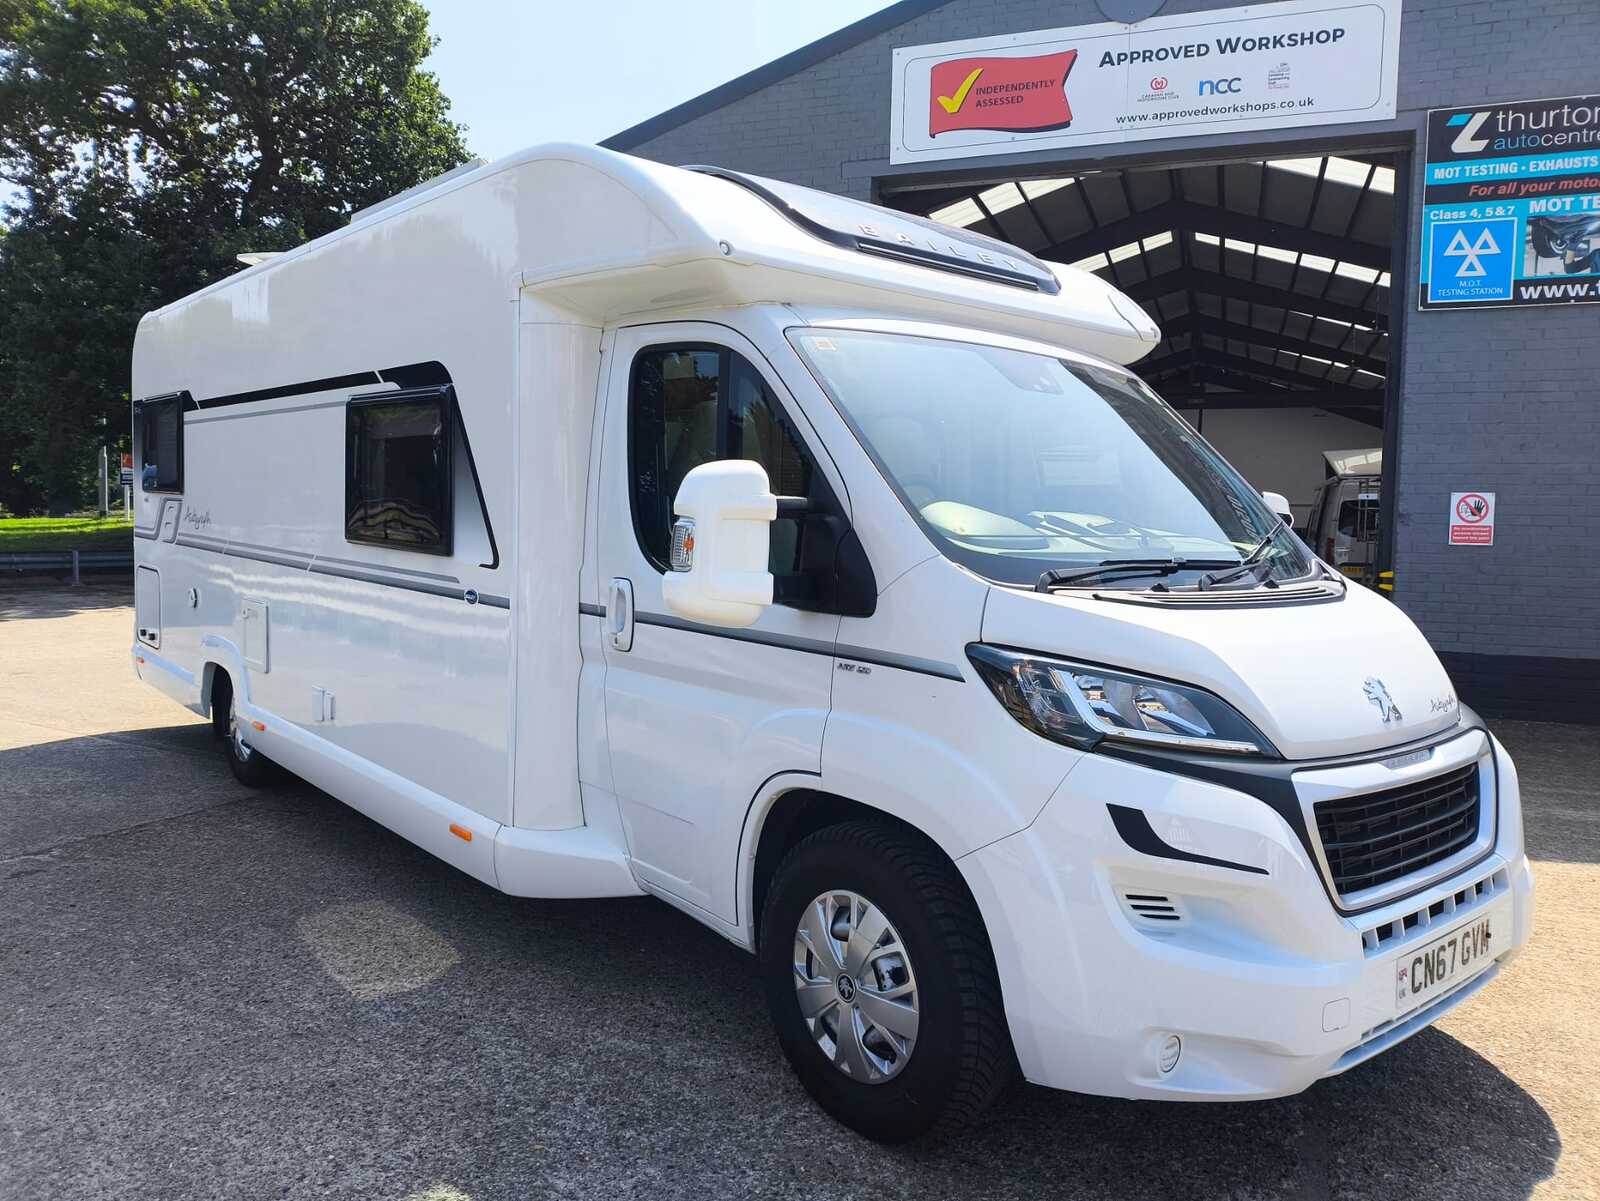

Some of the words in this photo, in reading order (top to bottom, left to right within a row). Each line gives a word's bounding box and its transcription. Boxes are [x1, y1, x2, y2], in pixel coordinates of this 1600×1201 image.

[1099, 43, 1210, 67] APPROVED
[1216, 28, 1345, 55] WORKSHOP
[976, 80, 1056, 95] INDEPENDENTLY
[1199, 77, 1242, 96] ncc
[976, 95, 1024, 108] ASSESSED
[1116, 97, 1314, 123] www.approvedworkshops.co.uk
[1433, 166, 1462, 180] MOT
[1464, 162, 1518, 177] TESTING
[1529, 156, 1599, 172] EXHAUSTS
[1468, 185, 1494, 197] For
[1497, 182, 1517, 195] all
[1519, 181, 1555, 196] your
[1558, 177, 1600, 189] moto
[1430, 210, 1467, 220] Class
[1529, 199, 1574, 213] MOT
[858, 224, 1018, 270] BAILEY
[1438, 289, 1470, 297] TESTING
[1470, 287, 1504, 296] STATION
[1411, 937, 1457, 994] CN67
